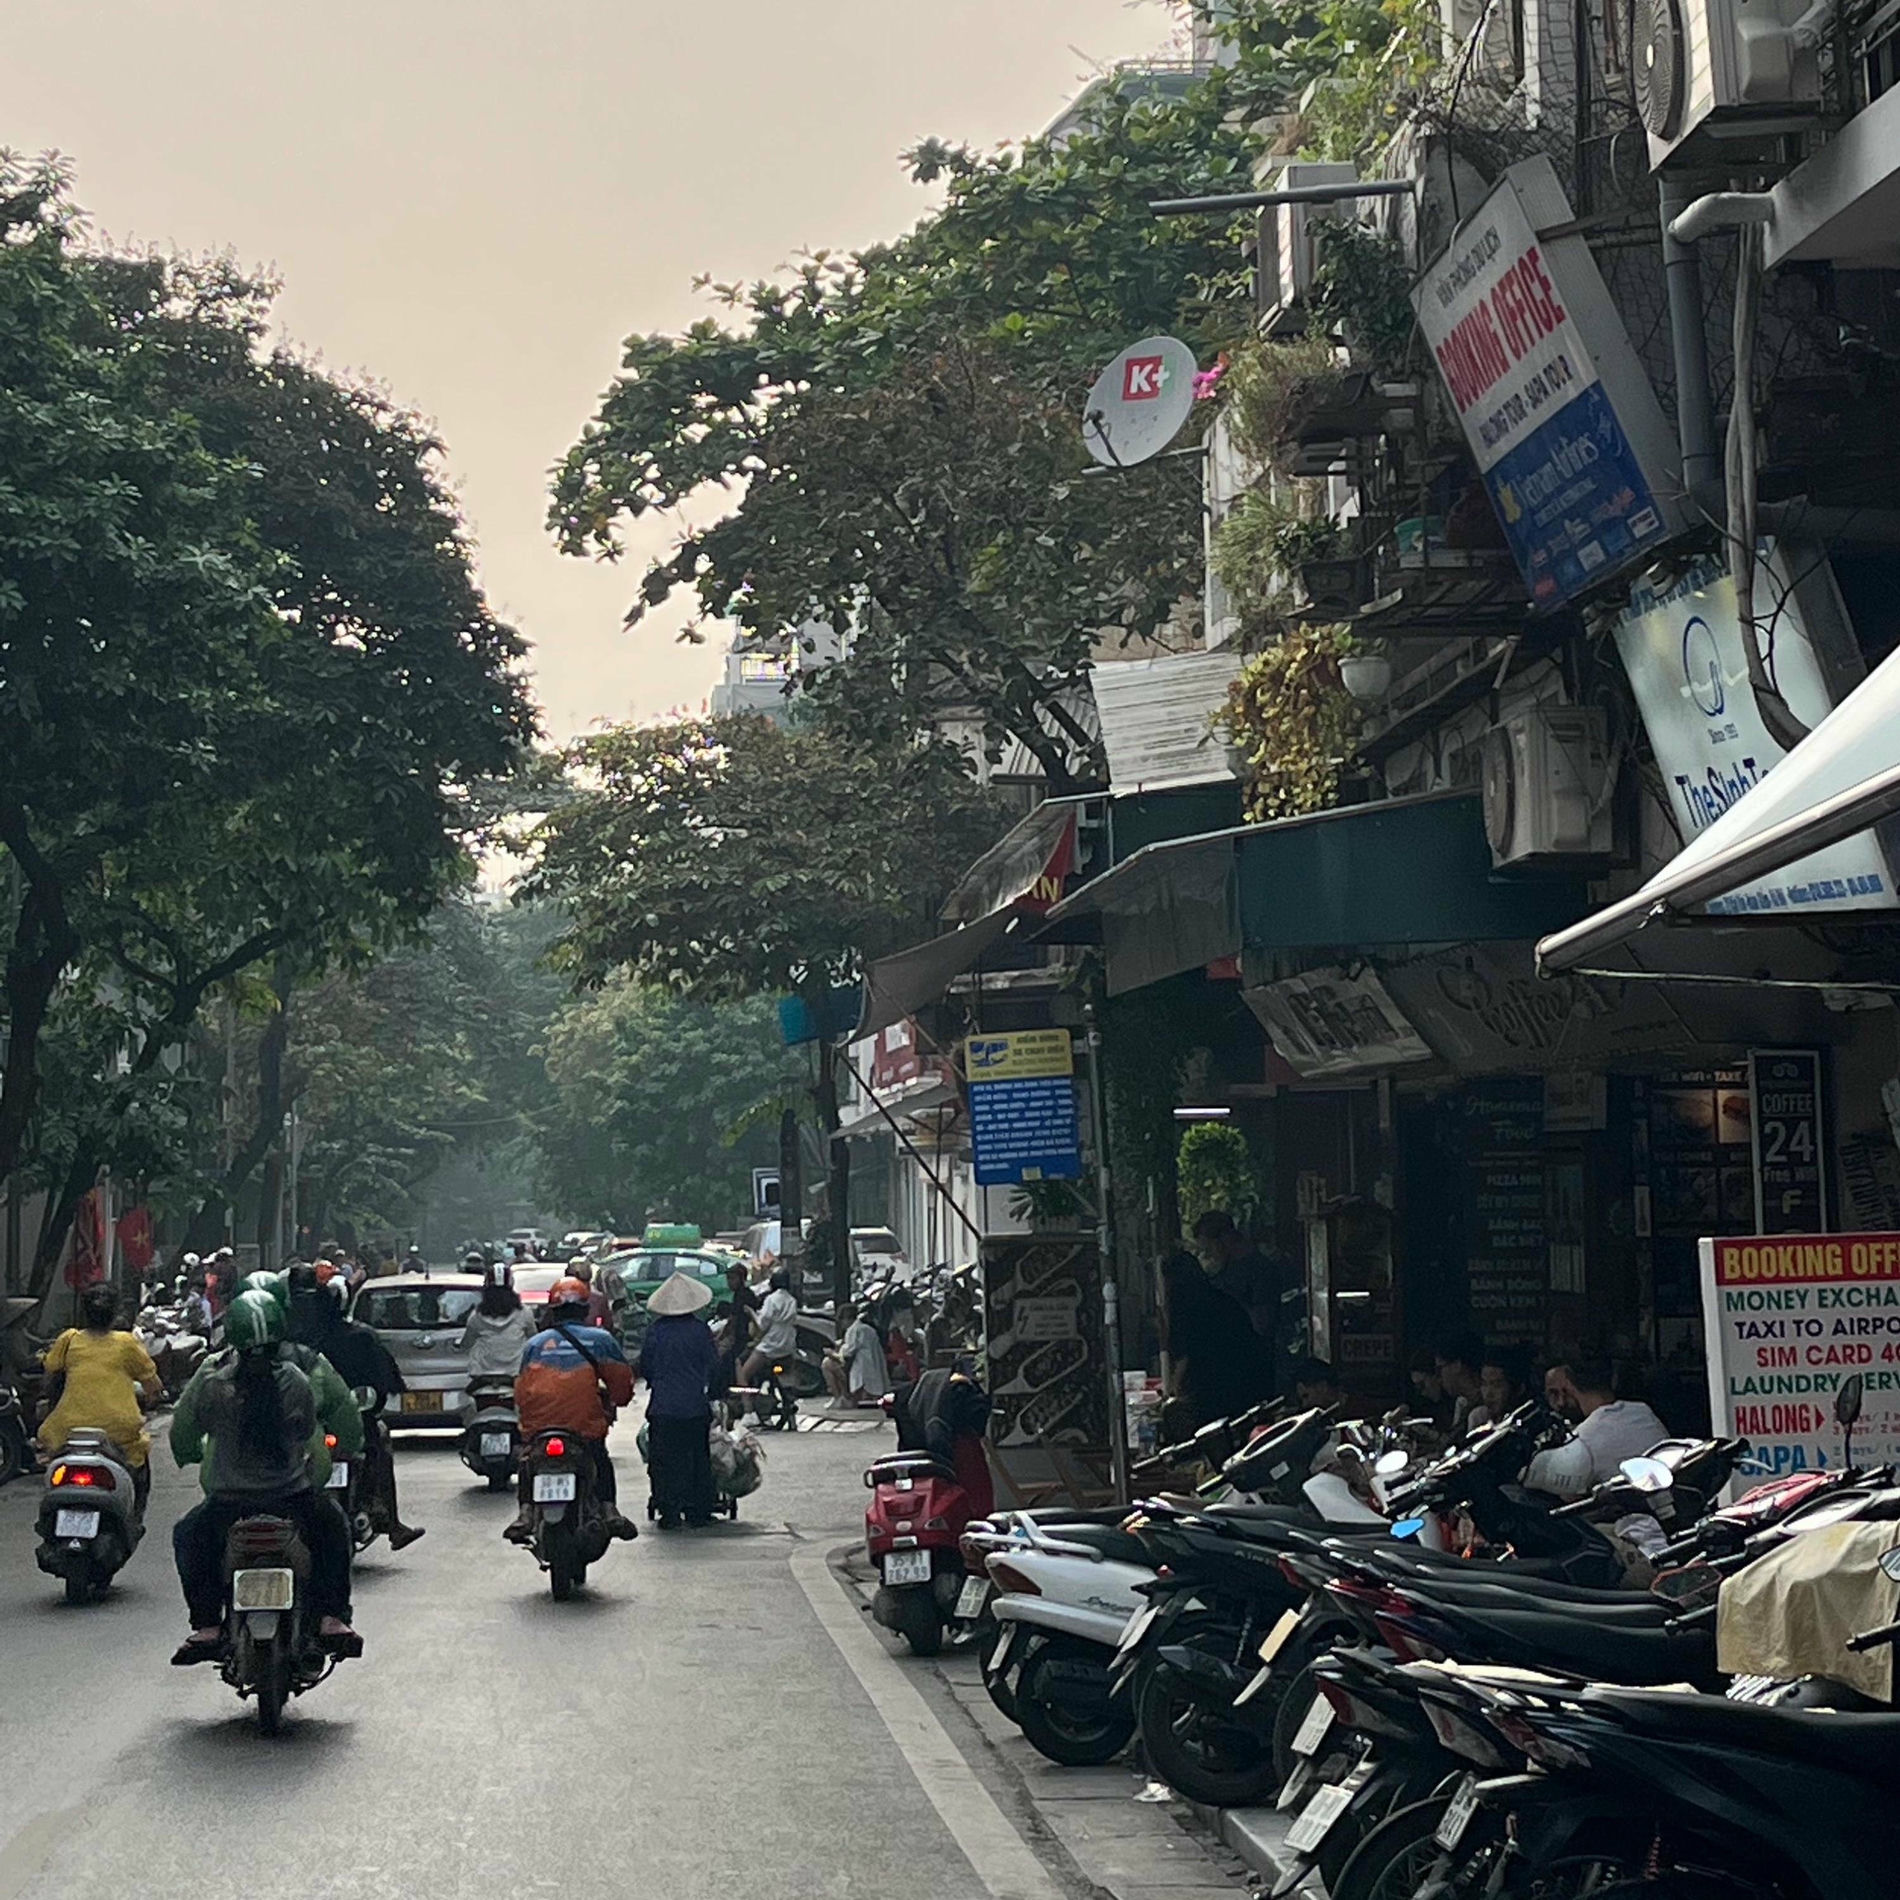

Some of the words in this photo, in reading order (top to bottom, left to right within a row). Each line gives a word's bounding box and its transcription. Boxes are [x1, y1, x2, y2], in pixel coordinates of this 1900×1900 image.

[1435, 298, 1511, 414] BOOKING
[1490, 245, 1566, 362] OFFICE
[1502, 392, 1528, 430] TOUR
[1523, 373, 1551, 410] SAPA
[1543, 354, 1573, 395] TOUR
[1762, 1093, 1813, 1114] COFFEE
[1763, 1120, 1815, 1163] 24
[1723, 1243, 1844, 1280] BOOKING
[1851, 1242, 1900, 1275] OFF
[1725, 1288, 1809, 1312] MONEY
[1817, 1286, 1900, 1308] EXCHA
[1734, 1320, 1786, 1340] TAXI
[1792, 1318, 1824, 1338] TO
[1831, 1316, 1900, 1337] AIRPO
[1756, 1346, 1798, 1368] SIM
[1805, 1343, 1873, 1366] CARD
[1730, 1372, 1841, 1396] LAUNDRY
[1863, 1371, 1900, 1391] ERV
[1735, 1403, 1811, 1435] HALONG
